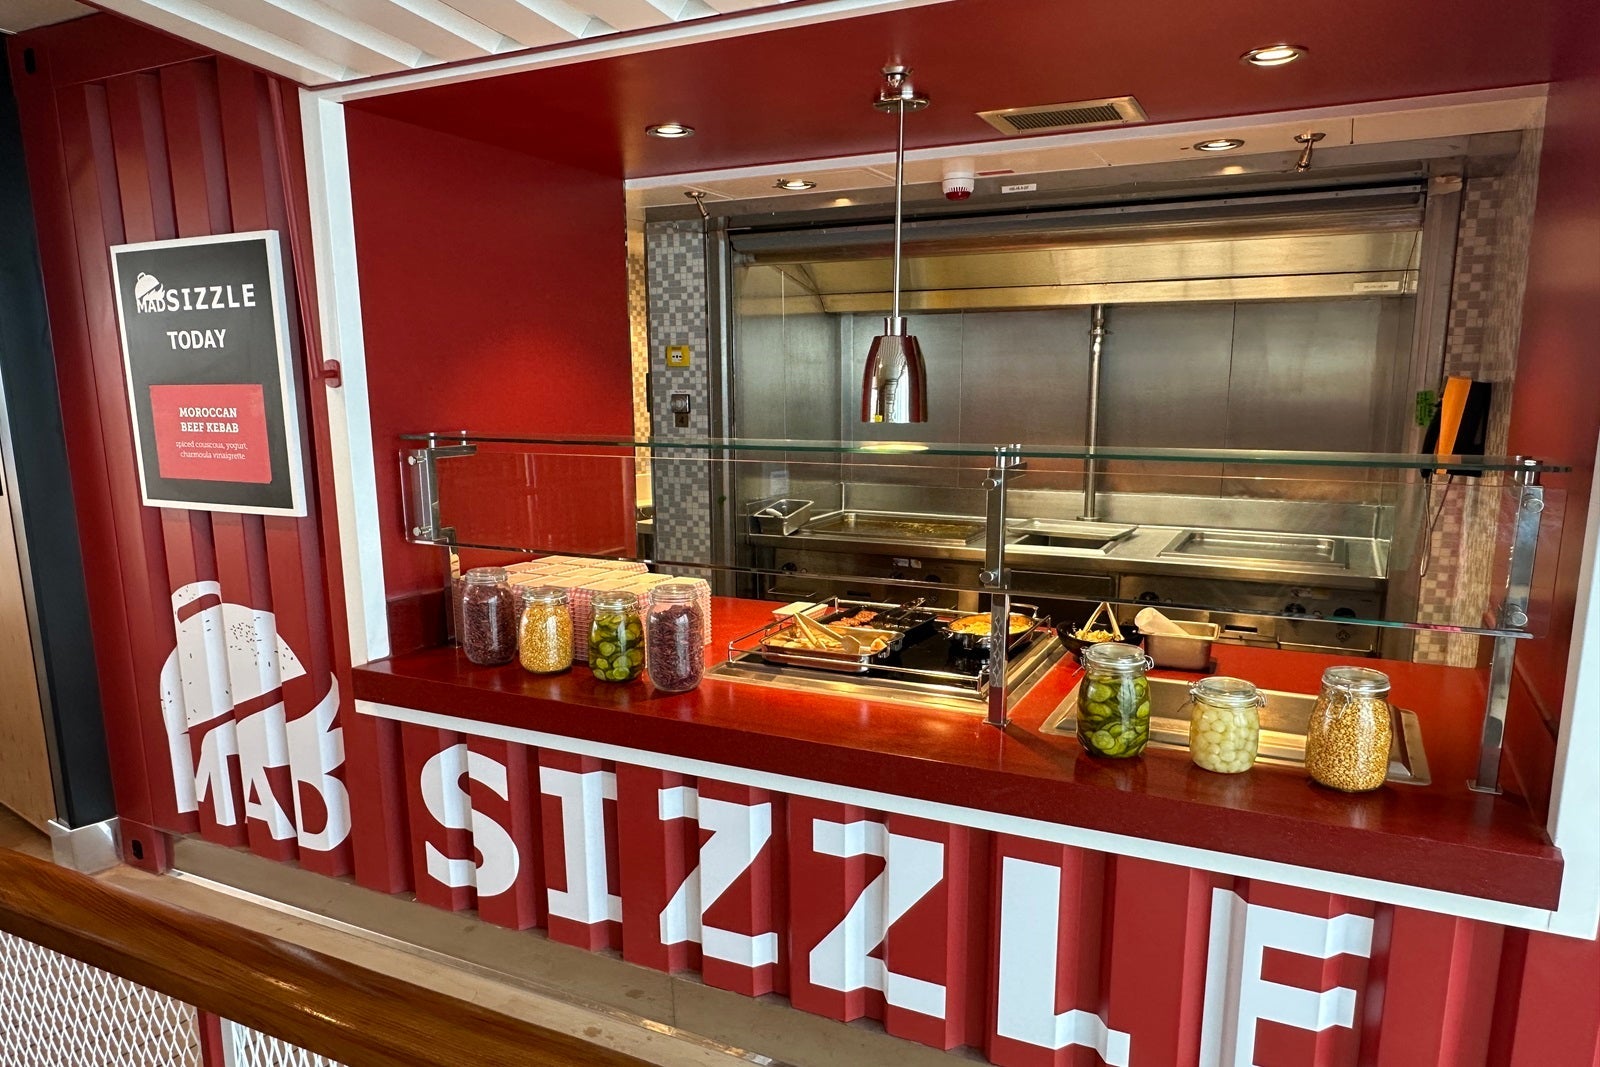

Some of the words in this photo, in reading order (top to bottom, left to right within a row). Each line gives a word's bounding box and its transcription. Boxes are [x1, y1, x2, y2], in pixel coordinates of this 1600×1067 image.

[136, 299, 166, 313] MAD
[166, 284, 256, 312] SIZZLE
[166, 328, 226, 350] TODAY
[179, 407, 237, 418] MOROCCAN
[181, 422, 204, 432] BEEF
[206, 422, 239, 433] KEBAB
[175, 441, 195, 449] spiced
[195, 442, 225, 450] couscous,
[180, 451, 212, 459] charmoula
[170, 732, 351, 851] MAD
[420, 743, 1373, 1067] SIZZLE
